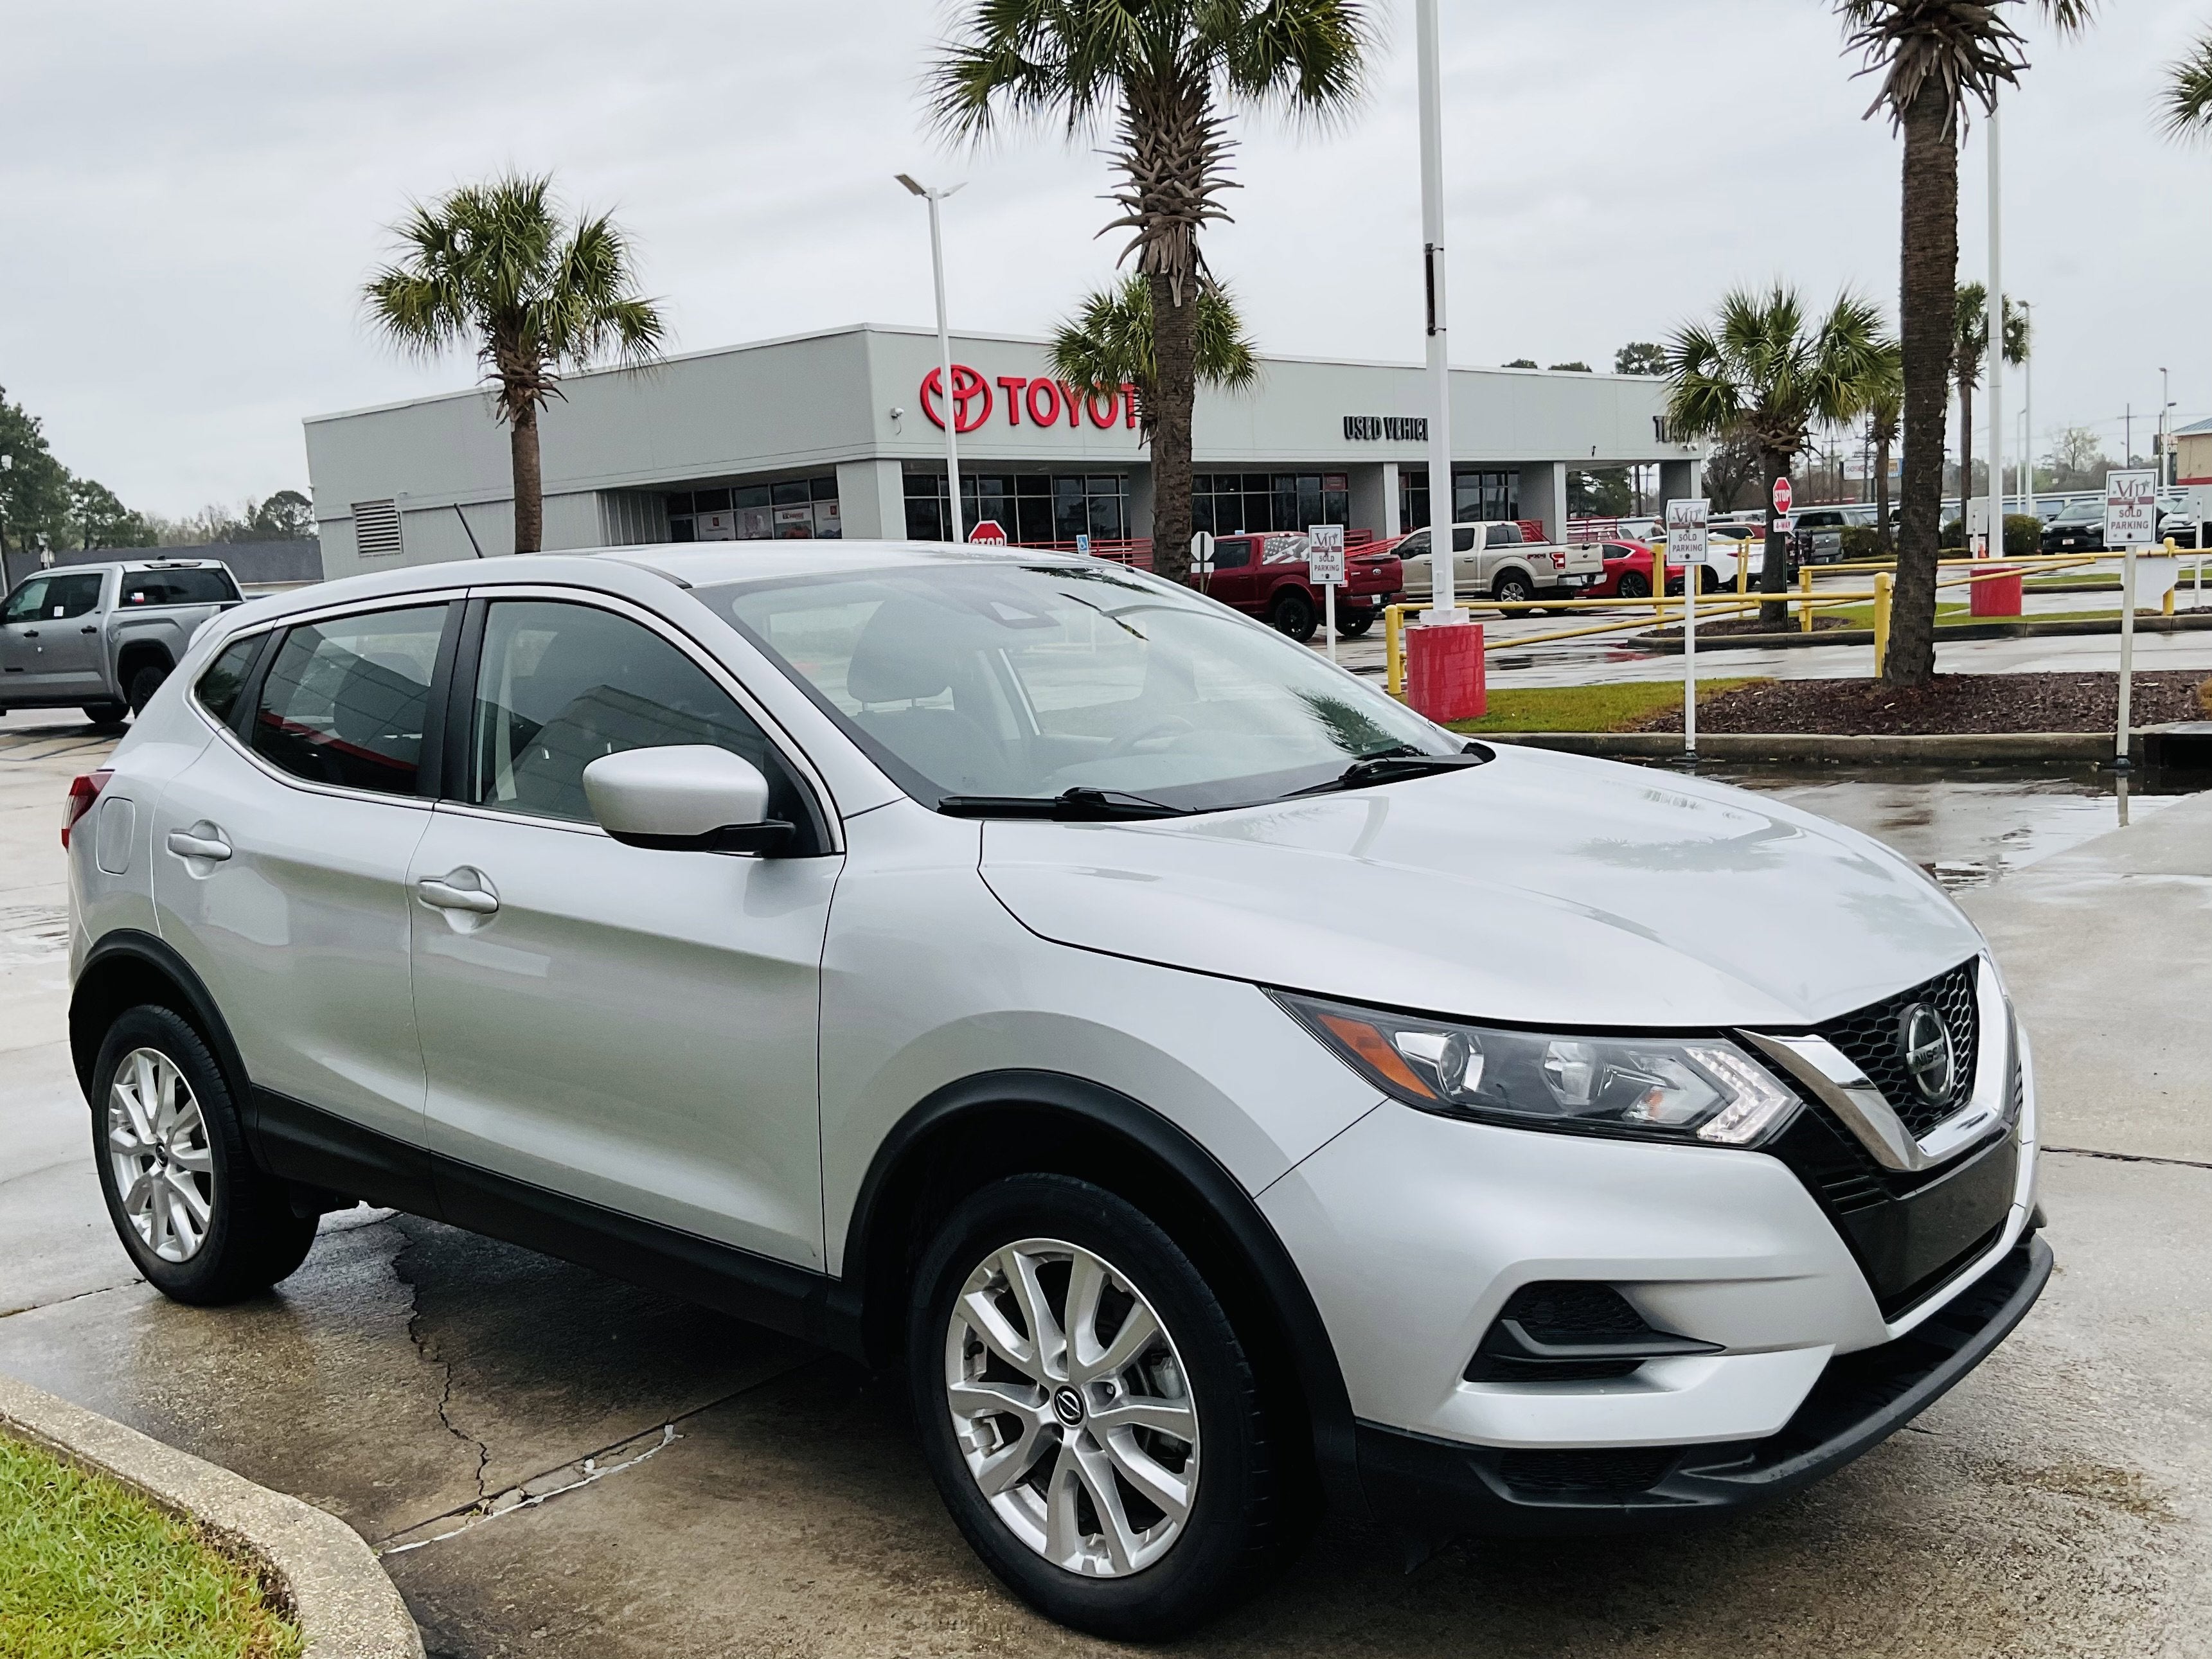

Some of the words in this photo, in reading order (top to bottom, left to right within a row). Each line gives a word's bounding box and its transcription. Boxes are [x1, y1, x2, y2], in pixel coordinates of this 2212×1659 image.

[997, 377, 1136, 429] TOYOT
[1343, 416, 1382, 439] USED
[1383, 417, 1428, 441] VEHIC
[1774, 490, 1790, 502] STOP
[2119, 510, 2142, 518] SOLD
[2111, 521, 2149, 530] PARKING
[1679, 533, 1697, 542] SOLD
[1672, 544, 1703, 553] PARKING
